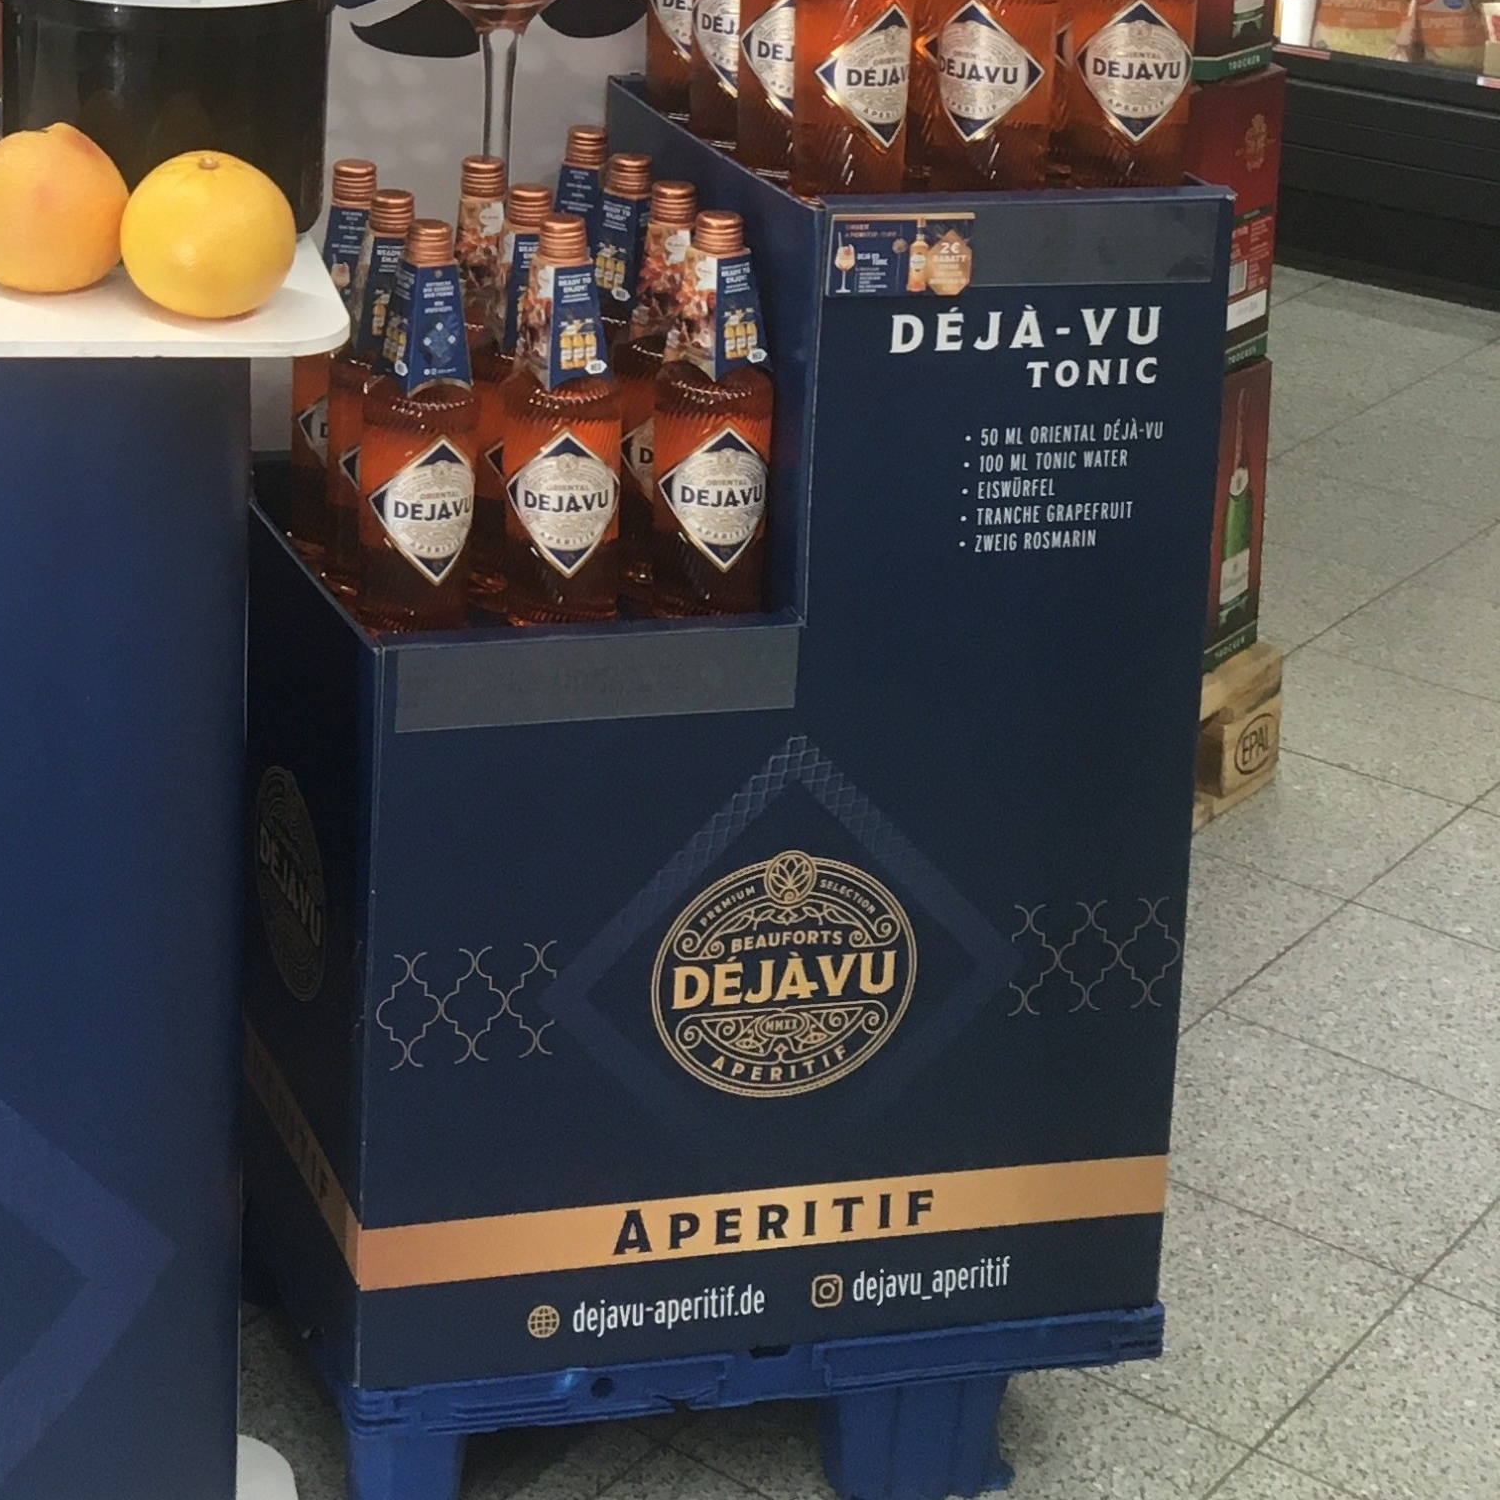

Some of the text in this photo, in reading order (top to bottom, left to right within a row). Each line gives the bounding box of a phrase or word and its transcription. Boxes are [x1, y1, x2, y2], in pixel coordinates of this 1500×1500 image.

[889, 304, 1163, 354] DÉJÀ-VU
[1026, 357, 1159, 389] TONIC
[980, 417, 1164, 446] 50 ML ORIENTAL DÉJÀ-VU
[979, 449, 1129, 473] 100 ML TONIC WATER
[977, 476, 1056, 500] EISWÜRFEL
[976, 500, 1134, 526] TRANCHE GRAPEFRUIT
[974, 529, 1097, 553] ZWEIG ROSMARIN
[699, 878, 877, 927] PREMIUM SELECTION
[730, 930, 844, 954] BEAUFORTS
[711, 1043, 849, 1082] APERITIF
[612, 1189, 936, 1256] APERITIF
[572, 1255, 1011, 1338] dejavu-aperitif.de dejavu_aperitif
